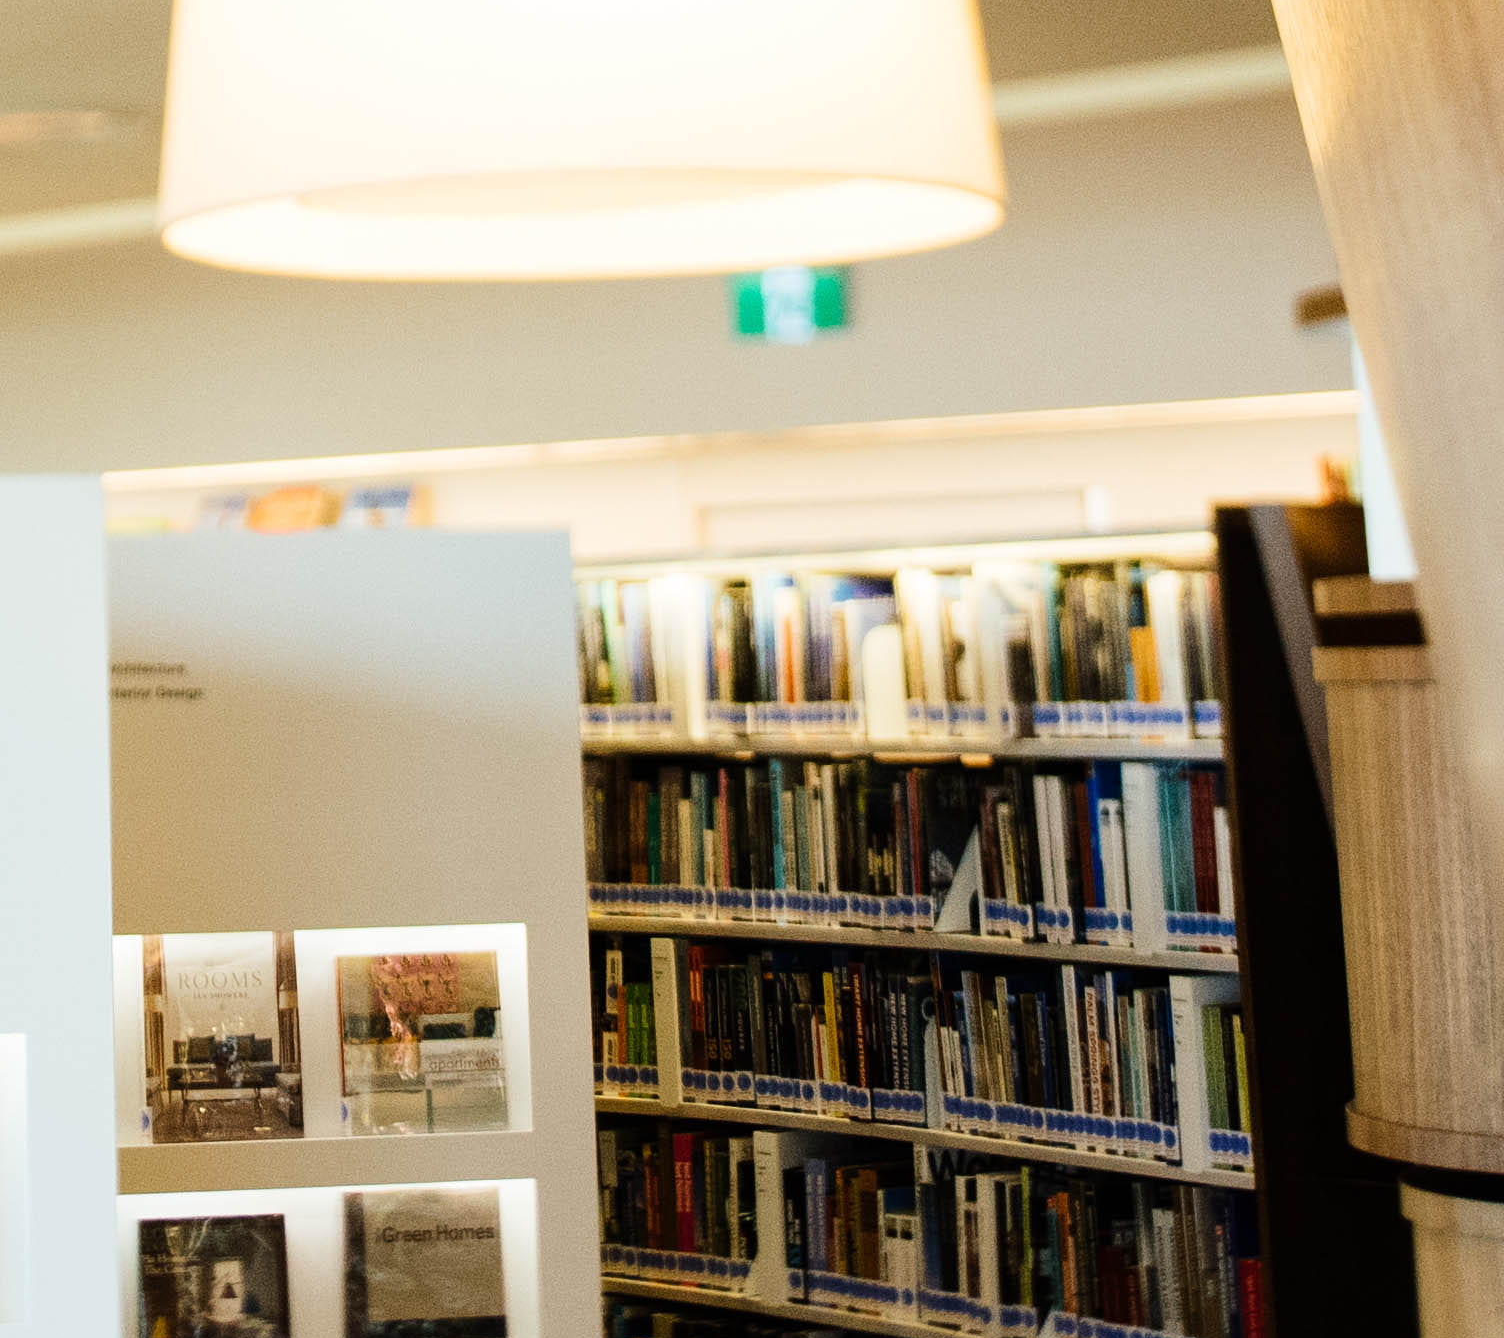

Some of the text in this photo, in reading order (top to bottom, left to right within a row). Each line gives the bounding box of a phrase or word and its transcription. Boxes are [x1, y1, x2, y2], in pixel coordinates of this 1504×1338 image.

[178, 970, 262, 990] ROOMS
[1086, 992, 1095, 1026] PALM
[1088, 1030, 1098, 1084] SPRINGS
[382, 1224, 495, 1243] Green Homes
